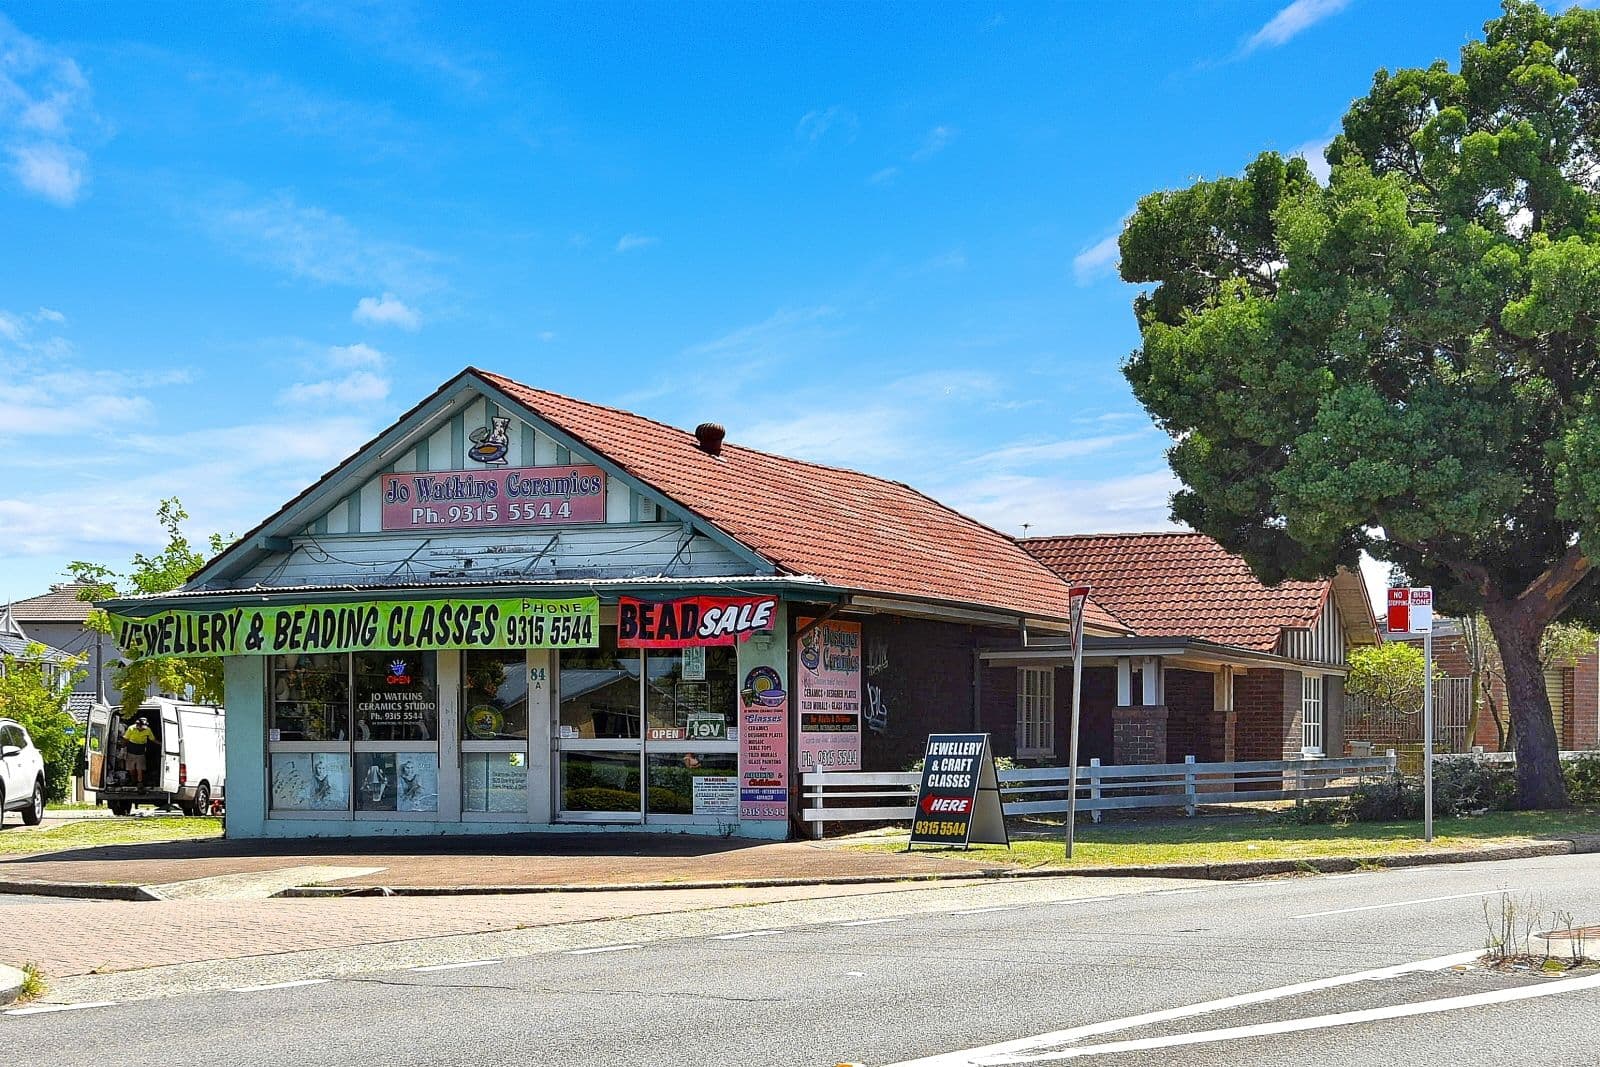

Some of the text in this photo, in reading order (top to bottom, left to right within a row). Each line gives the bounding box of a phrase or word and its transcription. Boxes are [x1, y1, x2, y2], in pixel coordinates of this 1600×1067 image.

[385, 470, 601, 502] Jo Watkins Ceramics
[508, 501, 573, 521] 5544
[1393, 591, 1403, 599] NO
[1413, 591, 1429, 599] BUS
[522, 603, 582, 613] PHONE
[619, 600, 776, 640] BEAD SALE
[245, 611, 264, 651] &
[273, 605, 379, 652] BEADING
[386, 603, 499, 648] CLASSES
[507, 614, 592, 645] 9315 5544
[386, 675, 411, 684] OPEN
[530, 668, 546, 681] 84
[535, 682, 542, 690] A
[371, 692, 423, 702] JO WATKINS
[358, 702, 436, 711] CERAMICS STUDIO
[384, 712, 401, 720] 9315
[403, 712, 423, 720] 5544
[652, 729, 679, 739] OPEN
[928, 742, 982, 756] JEWELLERY
[838, 749, 857, 766] 5544
[931, 758, 974, 772] & CRAFT
[927, 774, 971, 788] CLASSES
[741, 807, 760, 817] 9315
[763, 807, 786, 817] 5544
[930, 799, 969, 812] HERE
[915, 821, 966, 836] 9315 5544
